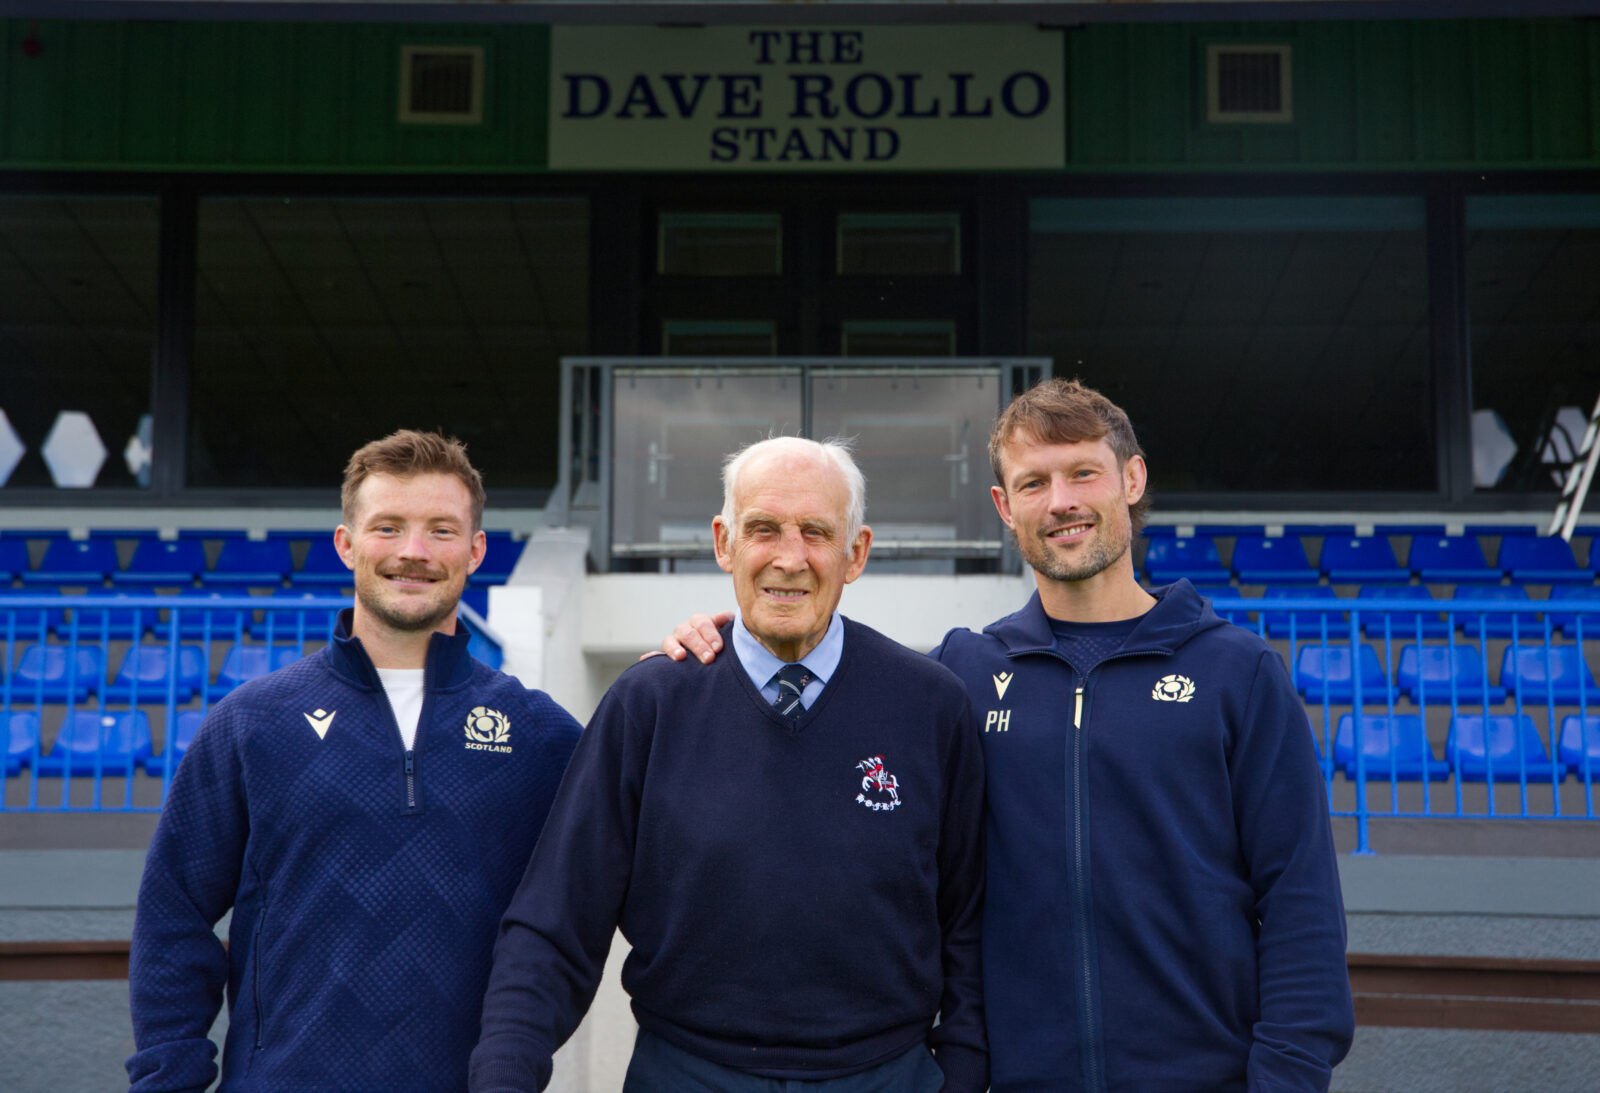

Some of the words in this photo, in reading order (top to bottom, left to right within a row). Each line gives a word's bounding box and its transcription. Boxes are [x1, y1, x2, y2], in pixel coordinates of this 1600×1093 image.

[749, 31, 863, 64] THE
[561, 74, 763, 119] DAVE
[788, 71, 1051, 120] ROLLO
[710, 127, 900, 162] STAND
[985, 709, 1011, 733] PH
[465, 742, 512, 753] SCOTLAND
